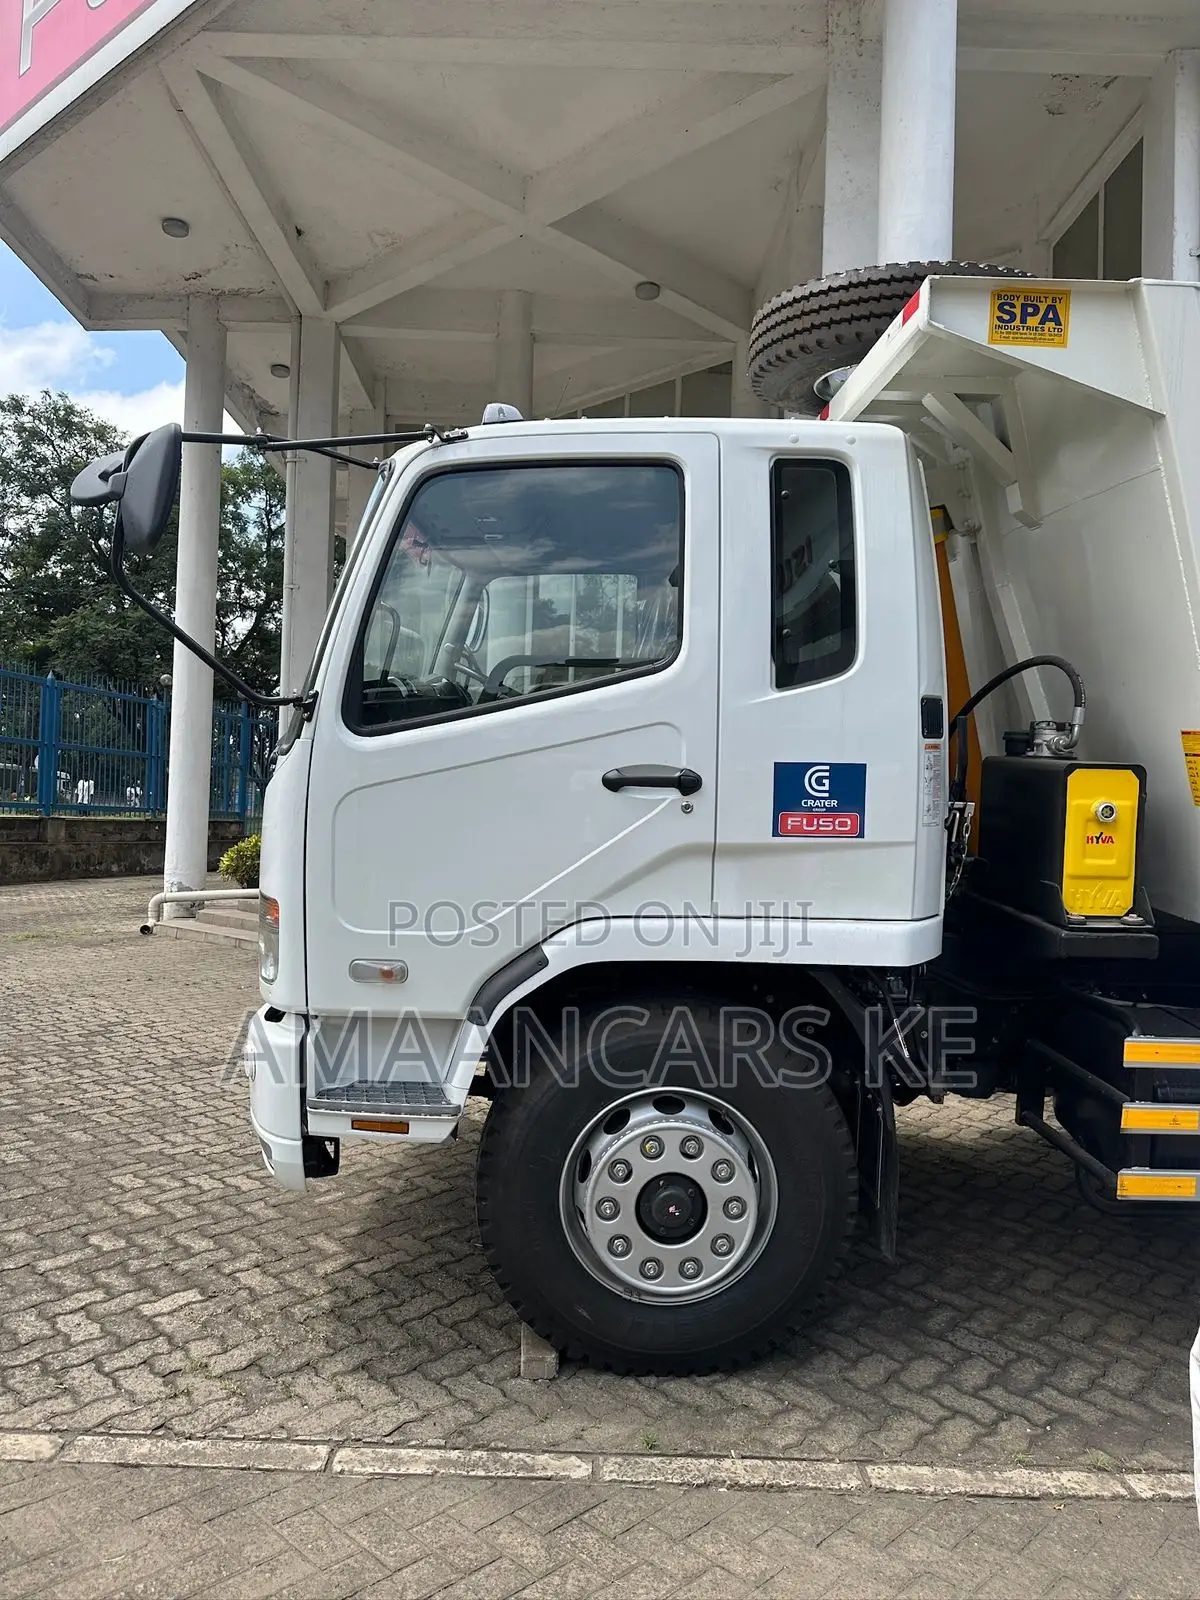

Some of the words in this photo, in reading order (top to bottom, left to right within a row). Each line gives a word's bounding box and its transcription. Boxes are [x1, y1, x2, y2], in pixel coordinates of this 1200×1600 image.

[996, 294, 1021, 302] BODY
[1023, 295, 1049, 303] BUILT
[1051, 296, 1063, 304] BY
[996, 301, 1063, 327] SPA
[994, 324, 1045, 333] INDUSTRIES
[801, 799, 838, 808] CRATER
[787, 817, 852, 831] FUSO
[1086, 831, 1115, 845] HYVA
